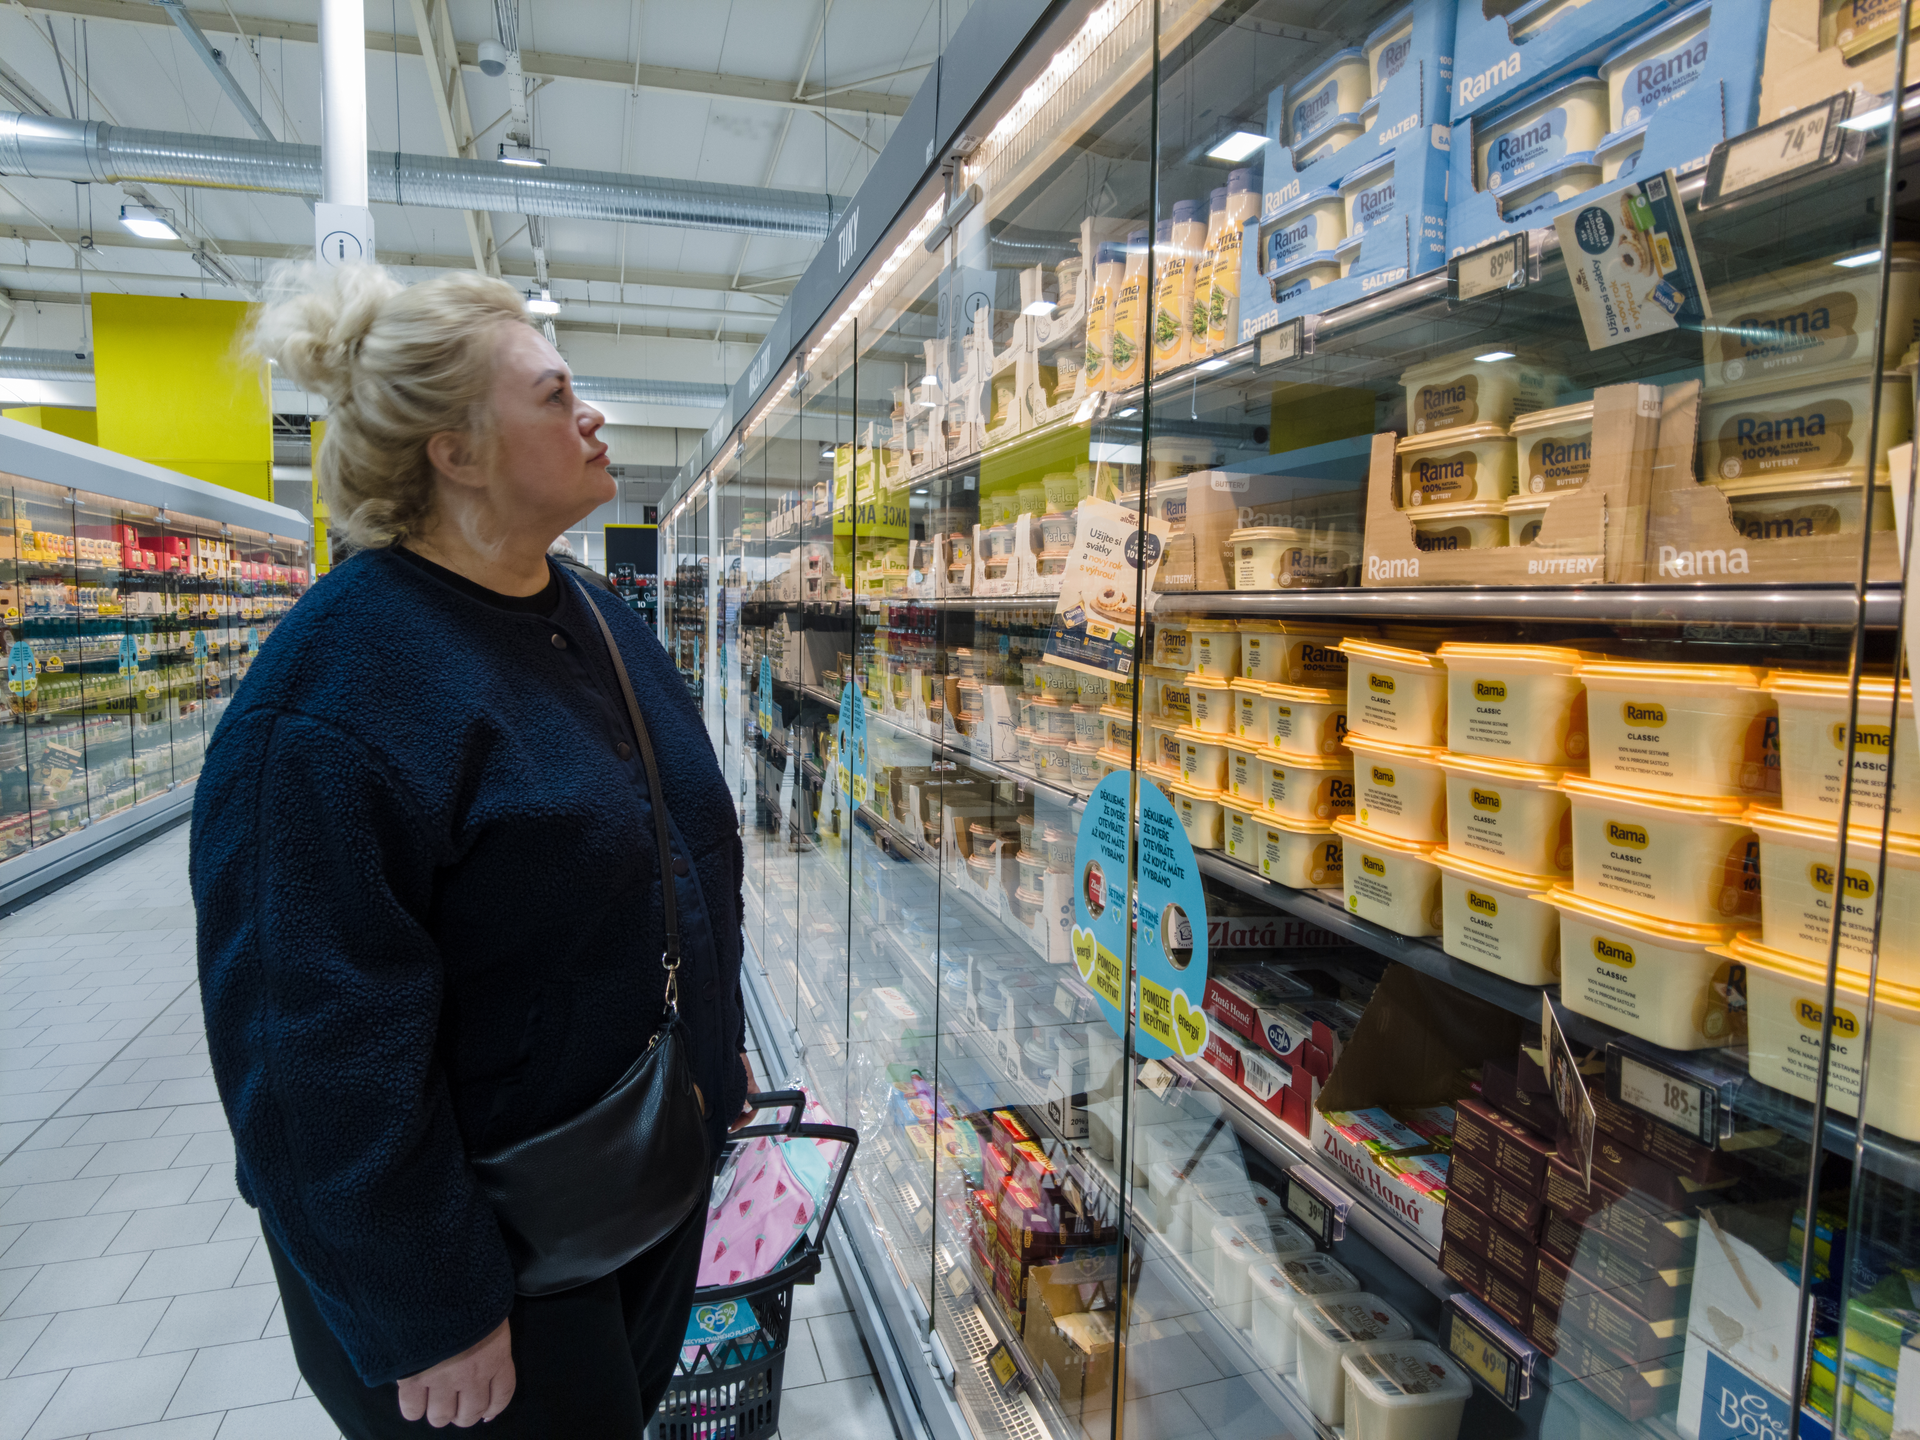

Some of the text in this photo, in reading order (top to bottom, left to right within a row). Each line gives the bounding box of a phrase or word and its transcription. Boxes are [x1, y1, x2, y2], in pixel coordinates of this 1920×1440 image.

[1855, 7, 1888, 28] 100%
[1637, 41, 1708, 94] Rama
[1459, 51, 1521, 106] Rama
[1672, 69, 1699, 87] NATURAL
[1640, 83, 1673, 107] 100%
[1300, 91, 1330, 121] Rama
[1379, 114, 1418, 146] SALTED
[1498, 121, 1551, 162] Rama
[1501, 156, 1525, 173] 100%
[1514, 162, 1535, 176] SALTED
[1265, 178, 1300, 214] Rama
[838, 205, 860, 273] TUKY
[1274, 223, 1308, 251] Rama
[1362, 267, 1405, 291] SALTED
[1592, 259, 1619, 337] Užijte svátky
[1610, 280, 1628, 326] nový rok
[1655, 291, 1675, 311] Rama
[1242, 309, 1278, 340] Rama
[1739, 307, 1830, 347] Rama
[1745, 343, 1784, 361] 100%
[1763, 354, 1804, 369] BUTTERY
[1423, 385, 1466, 410] Rama
[1426, 408, 1445, 420] 100%
[1434, 418, 1454, 427] BUTTERY
[1737, 413, 1826, 446] Rama
[1742, 445, 1780, 460] 100%
[1780, 441, 1814, 450] NATURAL
[1420, 461, 1464, 483] Rama
[1544, 466, 1571, 478] 100%
[1759, 457, 1800, 469] BUTTERY
[1215, 481, 1246, 489] BUTTERY
[1422, 483, 1442, 494] 100%
[1556, 477, 1584, 486] BUTTERY
[1048, 487, 1074, 504] Perla
[1430, 492, 1452, 500] BUTTERY
[1120, 516, 1139, 527] albert
[1238, 506, 1307, 529] Rama
[1044, 527, 1070, 543] Perla
[1090, 528, 1122, 546] Užijte si
[1086, 542, 1112, 556] svátky
[1088, 554, 1108, 568] nový
[1109, 559, 1123, 570] rok
[1291, 551, 1338, 569] Rama
[1368, 556, 1420, 580] Rama
[1528, 558, 1598, 575] BUTTERY
[1659, 546, 1750, 578] Rama
[1085, 566, 1116, 581] výhrou!
[1065, 608, 1082, 619] Rama
[1162, 631, 1186, 647] Rama
[1302, 645, 1348, 663] Rama
[1046, 672, 1076, 689] Perla
[1371, 676, 1394, 690] Rama
[1165, 687, 1190, 704] Rama
[1477, 683, 1504, 697] Rama
[1370, 696, 1391, 705] CLASSIC
[1477, 707, 1501, 715] CLASSIC
[1627, 706, 1664, 722] Rama
[1627, 733, 1660, 742] CLASSIC
[1630, 757, 1669, 767] PRIRODNI SASTOJCI
[1373, 769, 1394, 783] Rama
[1100, 789, 1126, 809] DĚKUJEME,
[1473, 791, 1499, 808] Rama
[1103, 805, 1126, 822] ŽE DVEŘE
[1143, 807, 1175, 830] DĚKUJEME,
[1473, 815, 1496, 825] CLASSIC
[1098, 816, 1126, 838] OTEVÍRÁTE,
[1143, 822, 1170, 842] ŽE DVEŘE
[1610, 825, 1646, 844] Rama
[1091, 827, 1125, 850] AŽ KDYŽ MÁTE
[1100, 844, 1125, 864] VYBRÁNO
[1143, 838, 1176, 861] OTEVÍRÁTE,
[1610, 851, 1642, 864] CLASSIC
[1142, 852, 1185, 880] AŽ KDYŽ MÁTE
[1364, 857, 1384, 873] Rama
[1142, 866, 1172, 889] VYBRÁNO
[1614, 875, 1652, 889] PRIRODNI SASTOJCI
[1631, 870, 1652, 880] SESTAVINE
[1470, 893, 1496, 912] Rama
[1470, 916, 1493, 929] CLASSIC
[1207, 921, 1276, 946] Zlatá
[1597, 940, 1633, 964] Rama
[1097, 952, 1120, 982] POMOZTE
[1596, 967, 1628, 983] CLASSIC
[1096, 974, 1119, 1001] NEPLÝTVAT
[1616, 987, 1636, 999] SESTAVINE
[1143, 986, 1170, 1014] POMOZTE
[1211, 989, 1250, 1025] Zlatá Haná
[1599, 991, 1635, 1009] PRIRODNI SASTOJCI
[1143, 1011, 1170, 1037] NEPLÝTVAT
[1269, 1030, 1289, 1049] OLMA
[1323, 1129, 1421, 1225] Zlatá Haná
[704, 1307, 735, 1329] 95%
[735, 1325, 756, 1336] PLASTU
